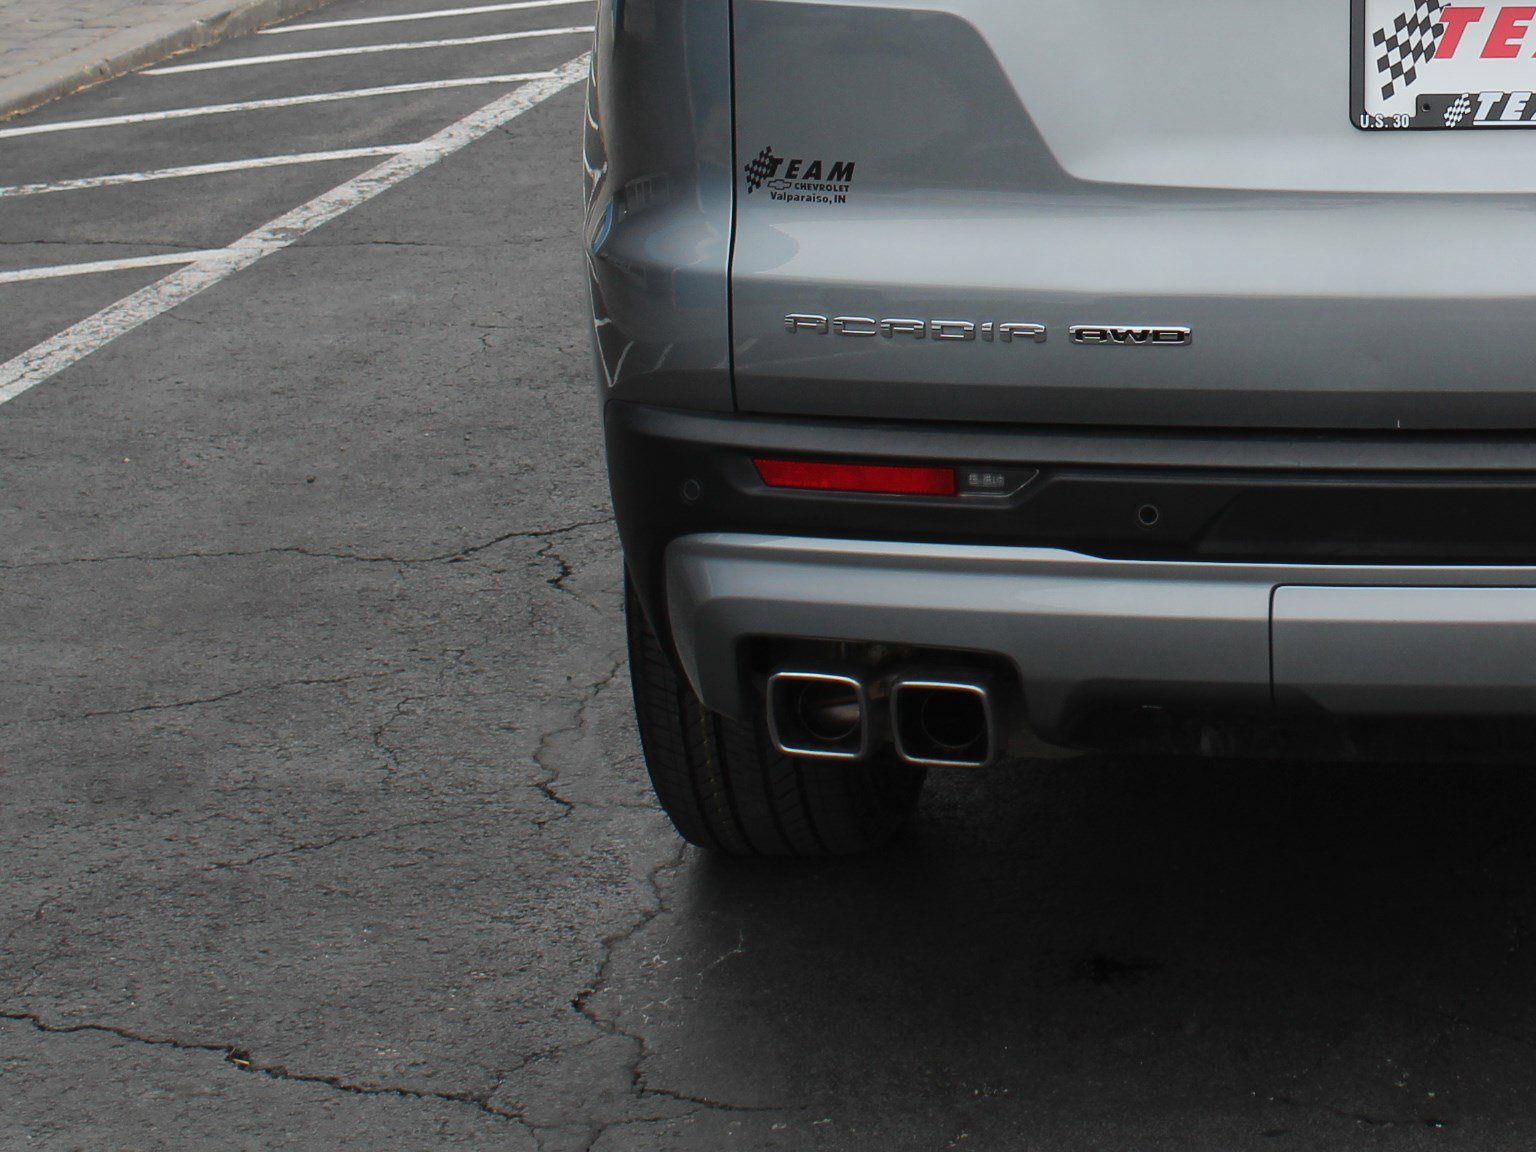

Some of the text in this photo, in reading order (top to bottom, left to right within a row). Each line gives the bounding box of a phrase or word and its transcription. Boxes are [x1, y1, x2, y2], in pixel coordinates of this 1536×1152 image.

[1360, 114, 1410, 129] U.S. 30
[766, 158, 856, 182] TEAM
[794, 182, 850, 193] CHEVROLET
[770, 191, 847, 204] Valparaiso, IN
[784, 313, 1192, 345] ACADIA AWD
